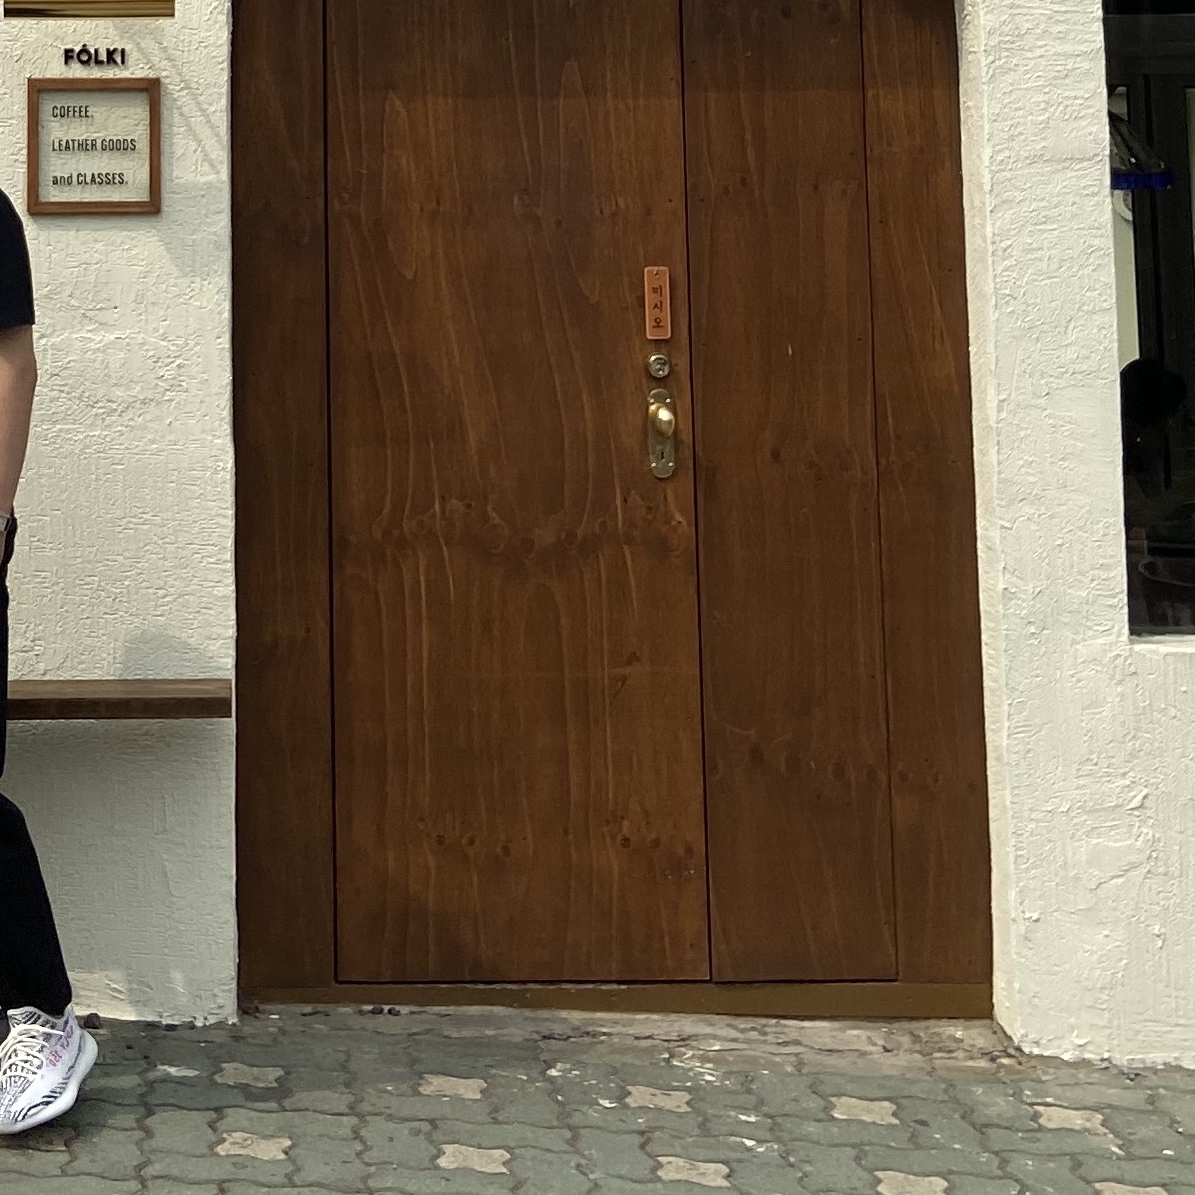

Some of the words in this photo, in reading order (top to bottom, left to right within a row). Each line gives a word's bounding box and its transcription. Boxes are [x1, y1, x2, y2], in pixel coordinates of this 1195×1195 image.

[63, 43, 126, 66] FÓLKI
[51, 138, 98, 152] LEATHER
[100, 138, 137, 152] GOODS
[51, 173, 73, 186] and
[76, 172, 129, 186] CLASSES.
[651, 284, 665, 329] 미시오
